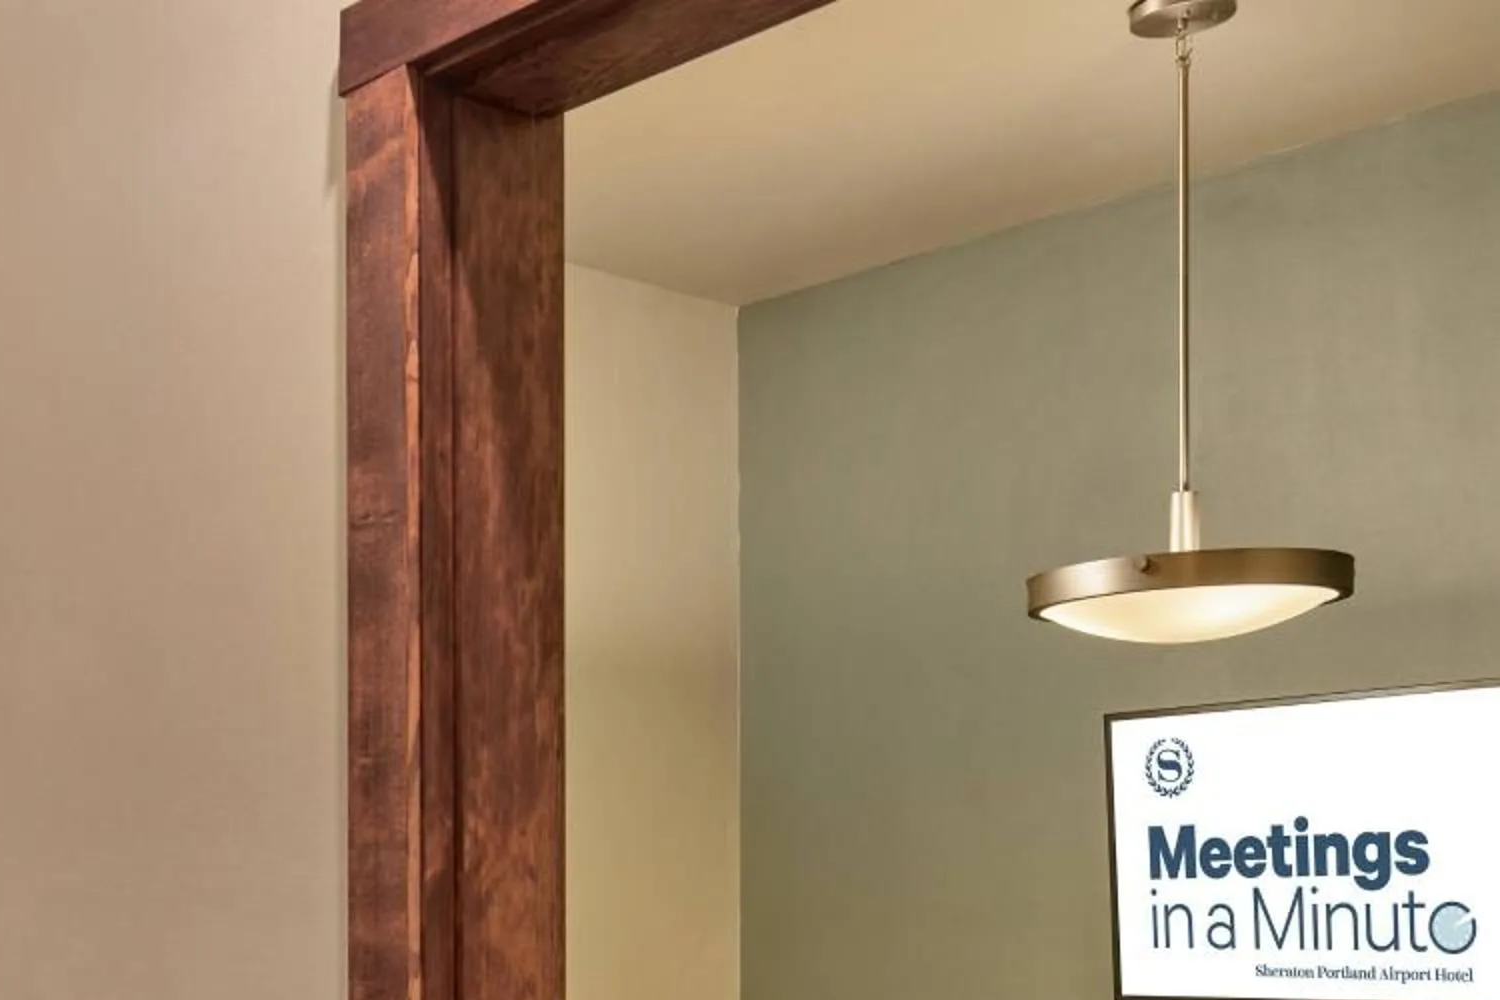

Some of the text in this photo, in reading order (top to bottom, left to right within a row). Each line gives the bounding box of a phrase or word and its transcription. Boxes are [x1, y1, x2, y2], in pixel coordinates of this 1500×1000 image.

[1148, 816, 1430, 891] Meetings
[1151, 888, 1194, 949] in
[1207, 903, 1236, 950] a
[1318, 965, 1376, 981] Portland
[1380, 966, 1431, 984] Airport
[1435, 967, 1474, 983] Hotel
